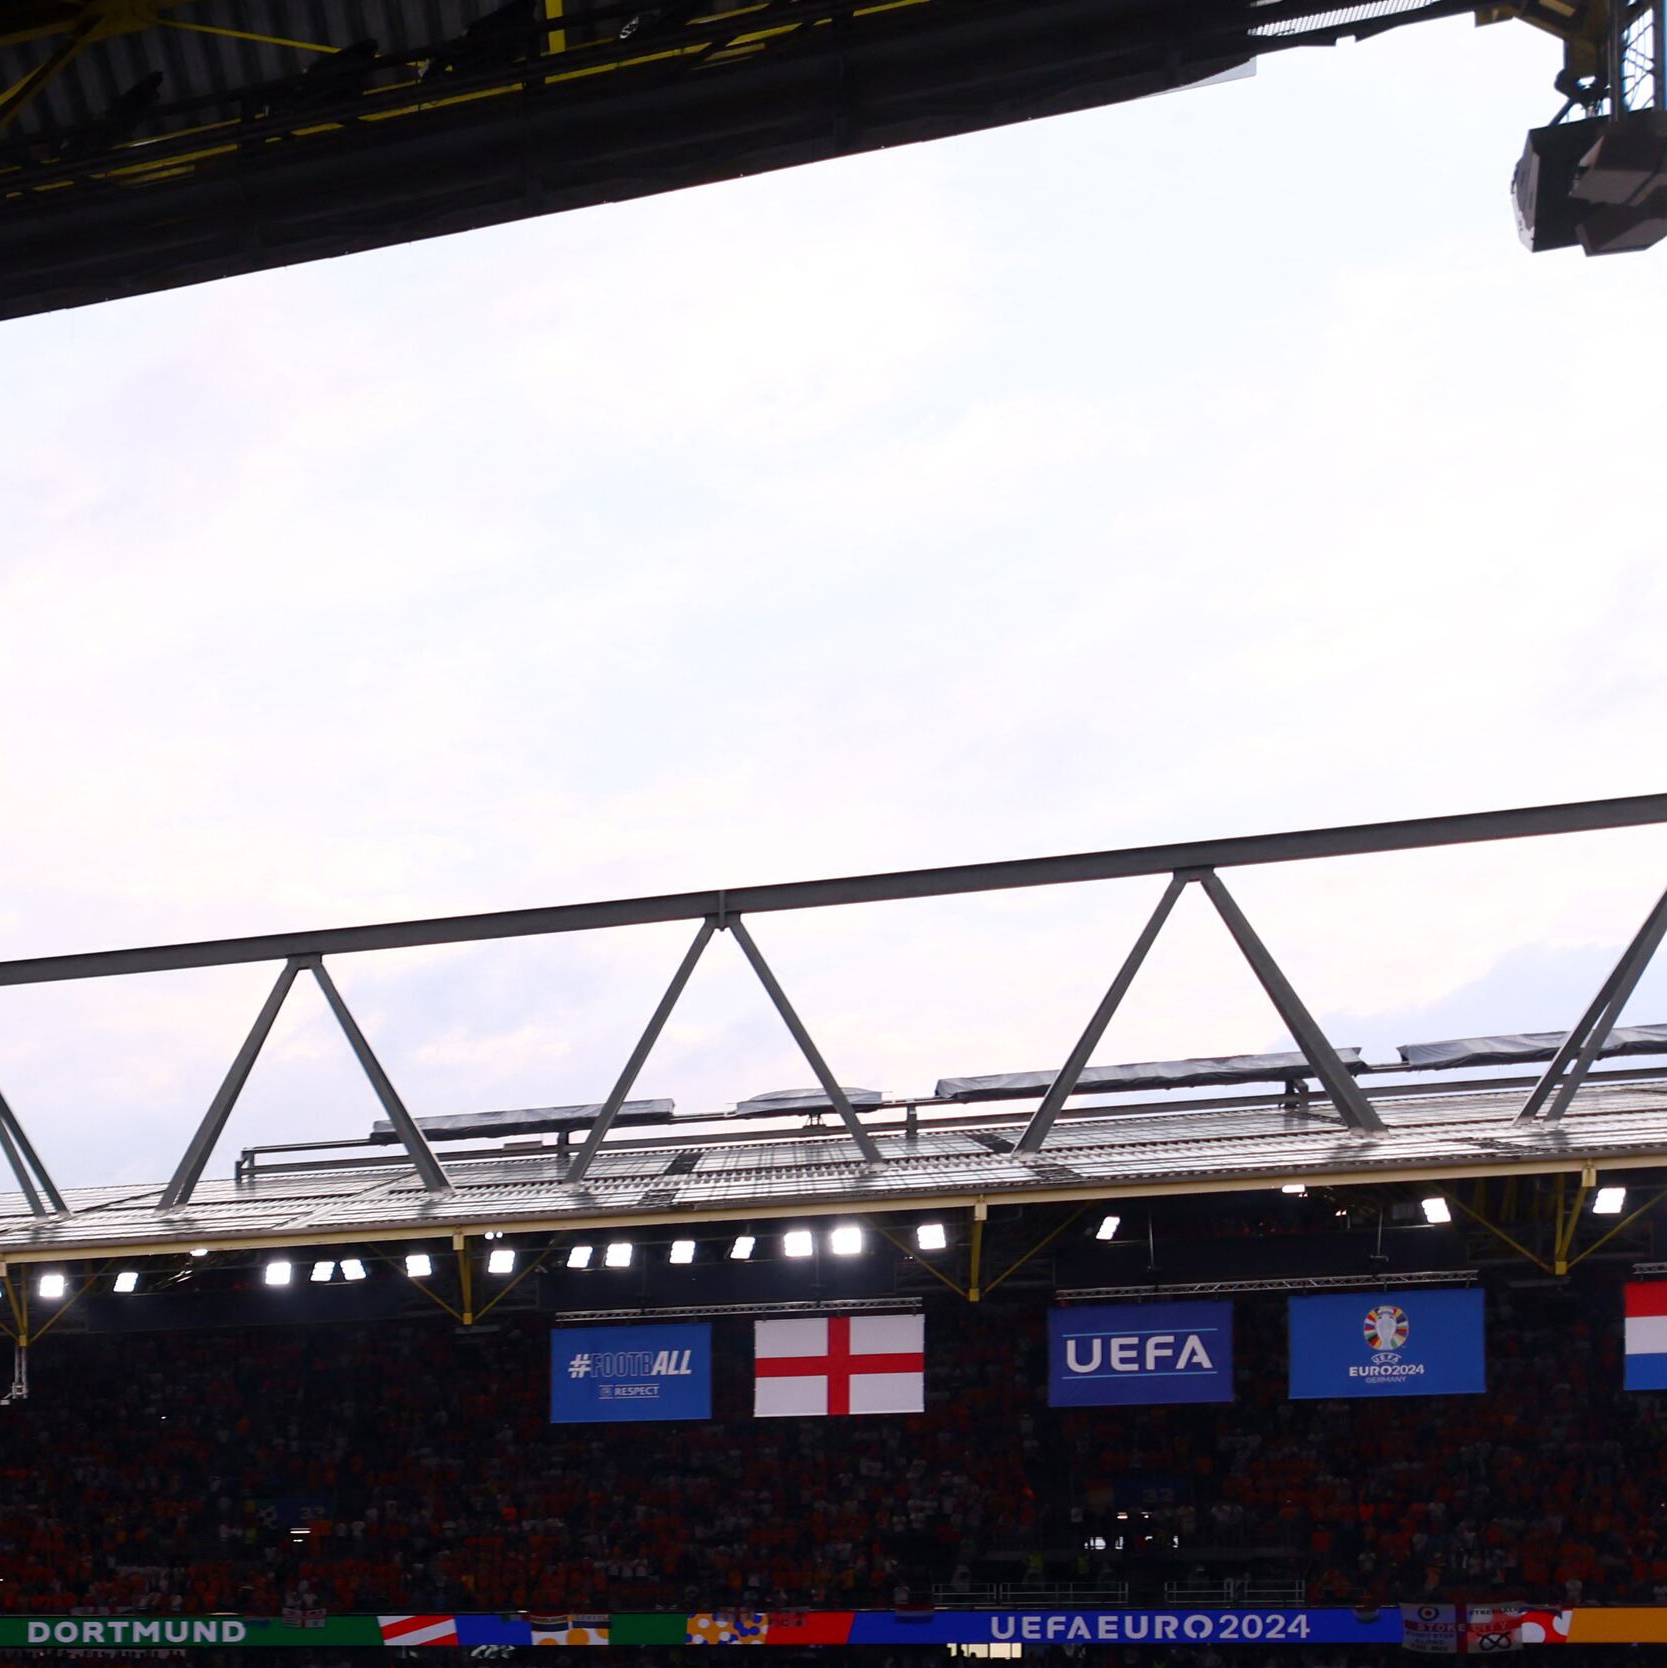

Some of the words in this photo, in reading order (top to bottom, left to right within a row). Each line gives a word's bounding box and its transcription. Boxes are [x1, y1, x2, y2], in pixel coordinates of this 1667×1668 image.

[1066, 1335, 1213, 1372] UEFA
[1370, 1353, 1403, 1364] UEFA
[1348, 1364, 1425, 1378] EURO2024
[614, 1385, 659, 1397] RESPECT
[27, 1621, 247, 1643] DORTMUND
